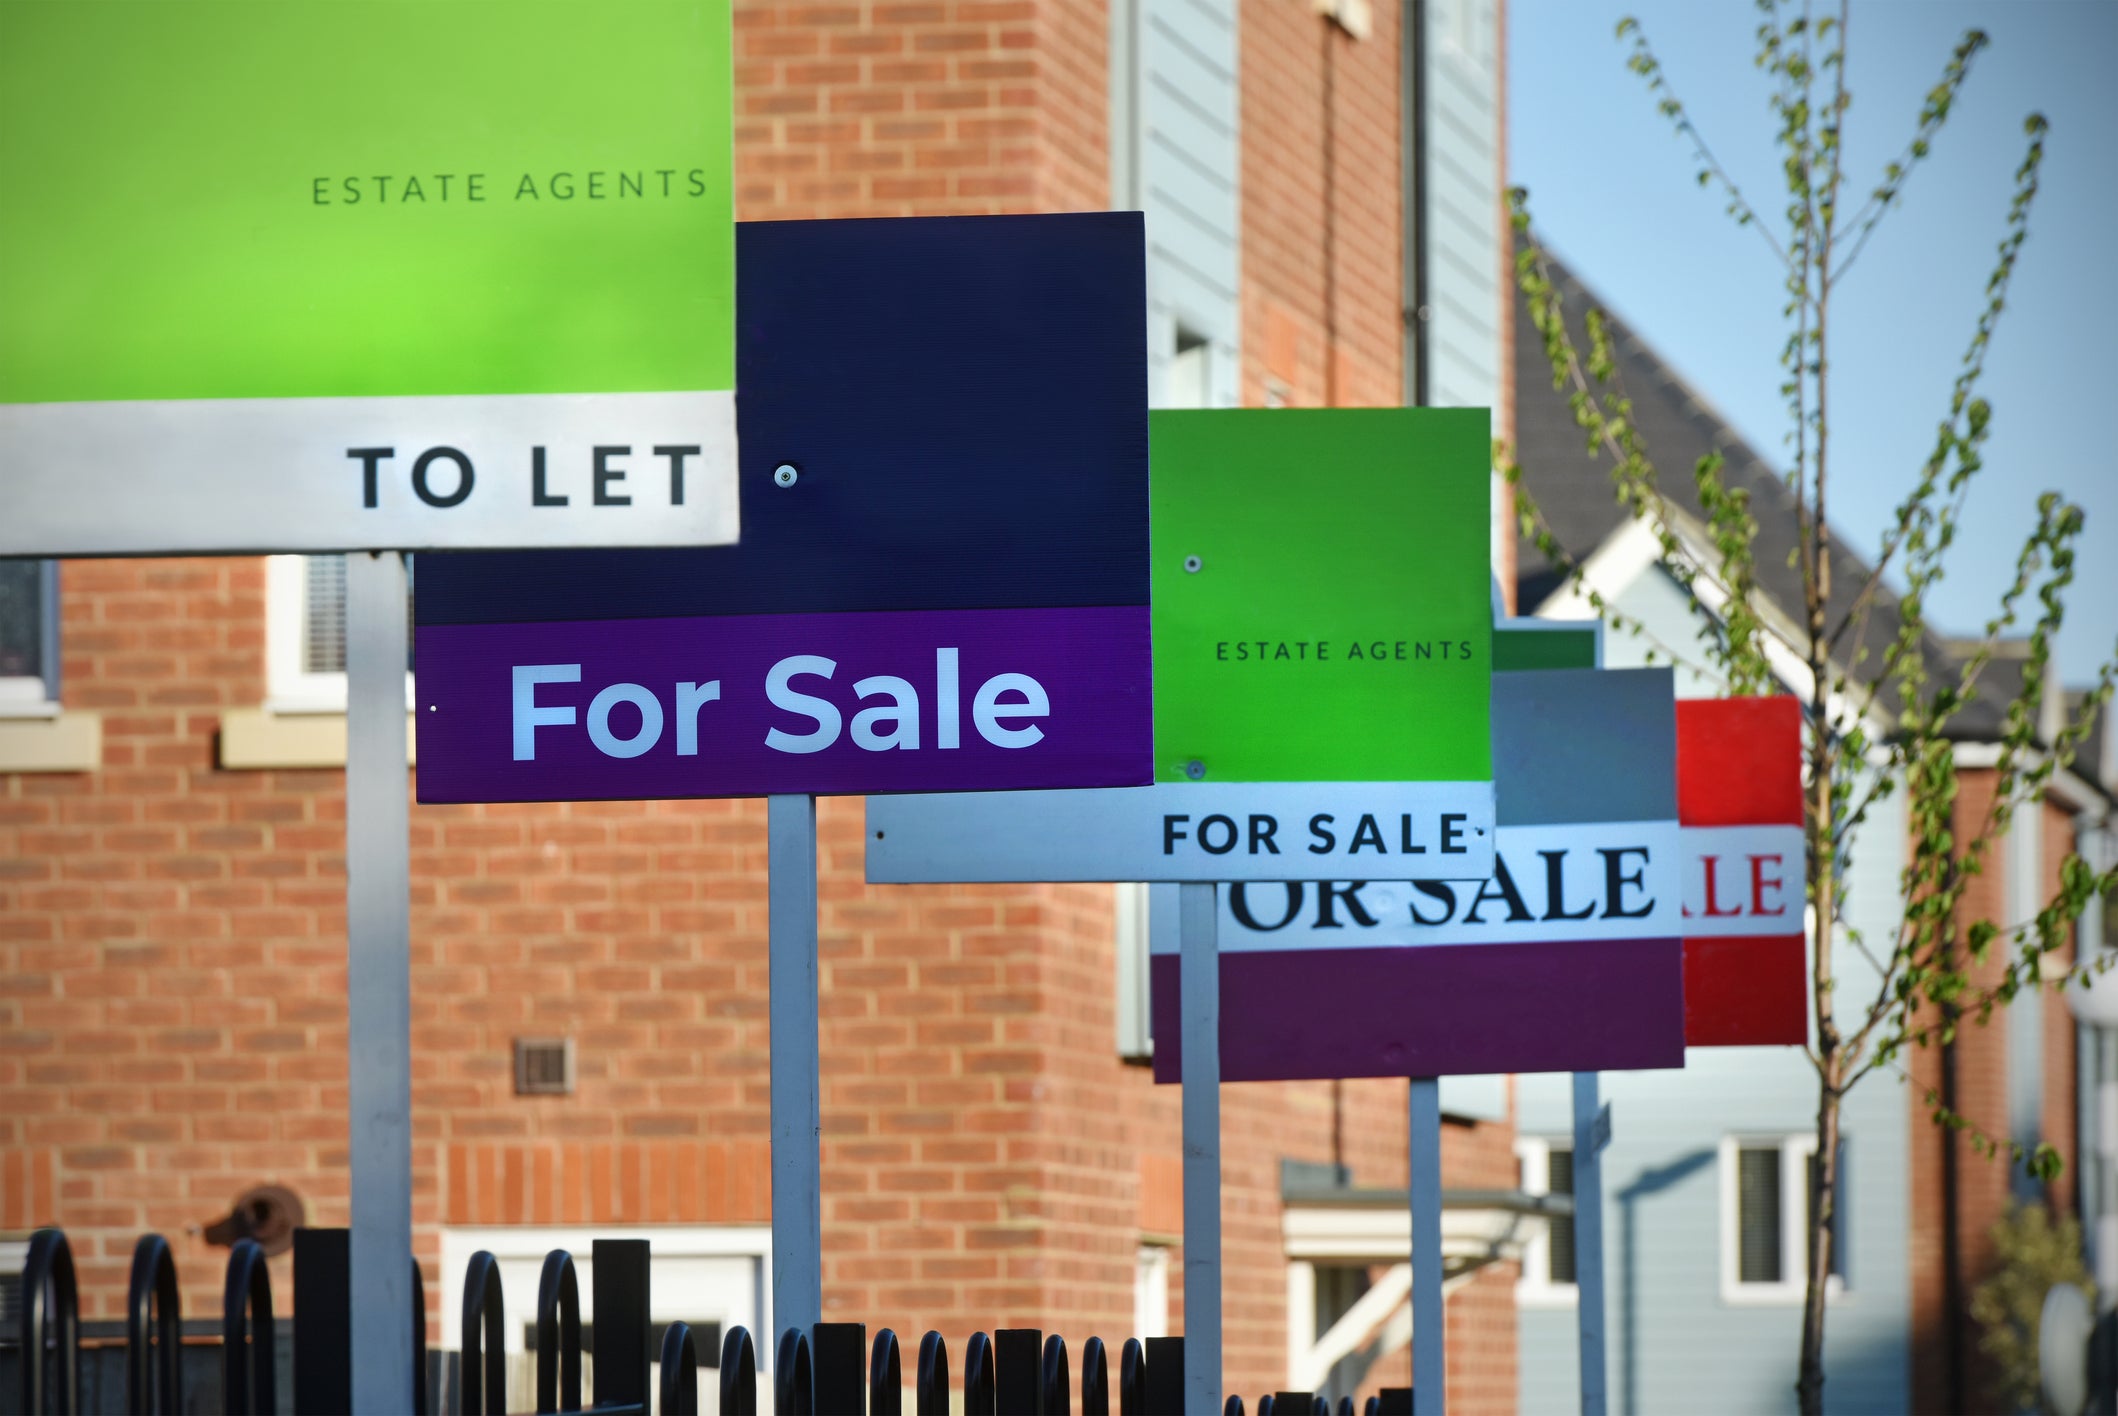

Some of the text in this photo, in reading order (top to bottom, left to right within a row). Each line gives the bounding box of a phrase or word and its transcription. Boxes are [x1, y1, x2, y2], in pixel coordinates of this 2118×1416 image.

[312, 168, 706, 205] ESTATE AGENTS
[346, 445, 701, 509] TO LET
[1216, 641, 1473, 661] ESTATE AGENTS
[512, 647, 1050, 761] For Sale
[1163, 813, 1467, 855] FOR SALE
[1229, 846, 1656, 932] OR SALE
[1682, 854, 1786, 917] LE
